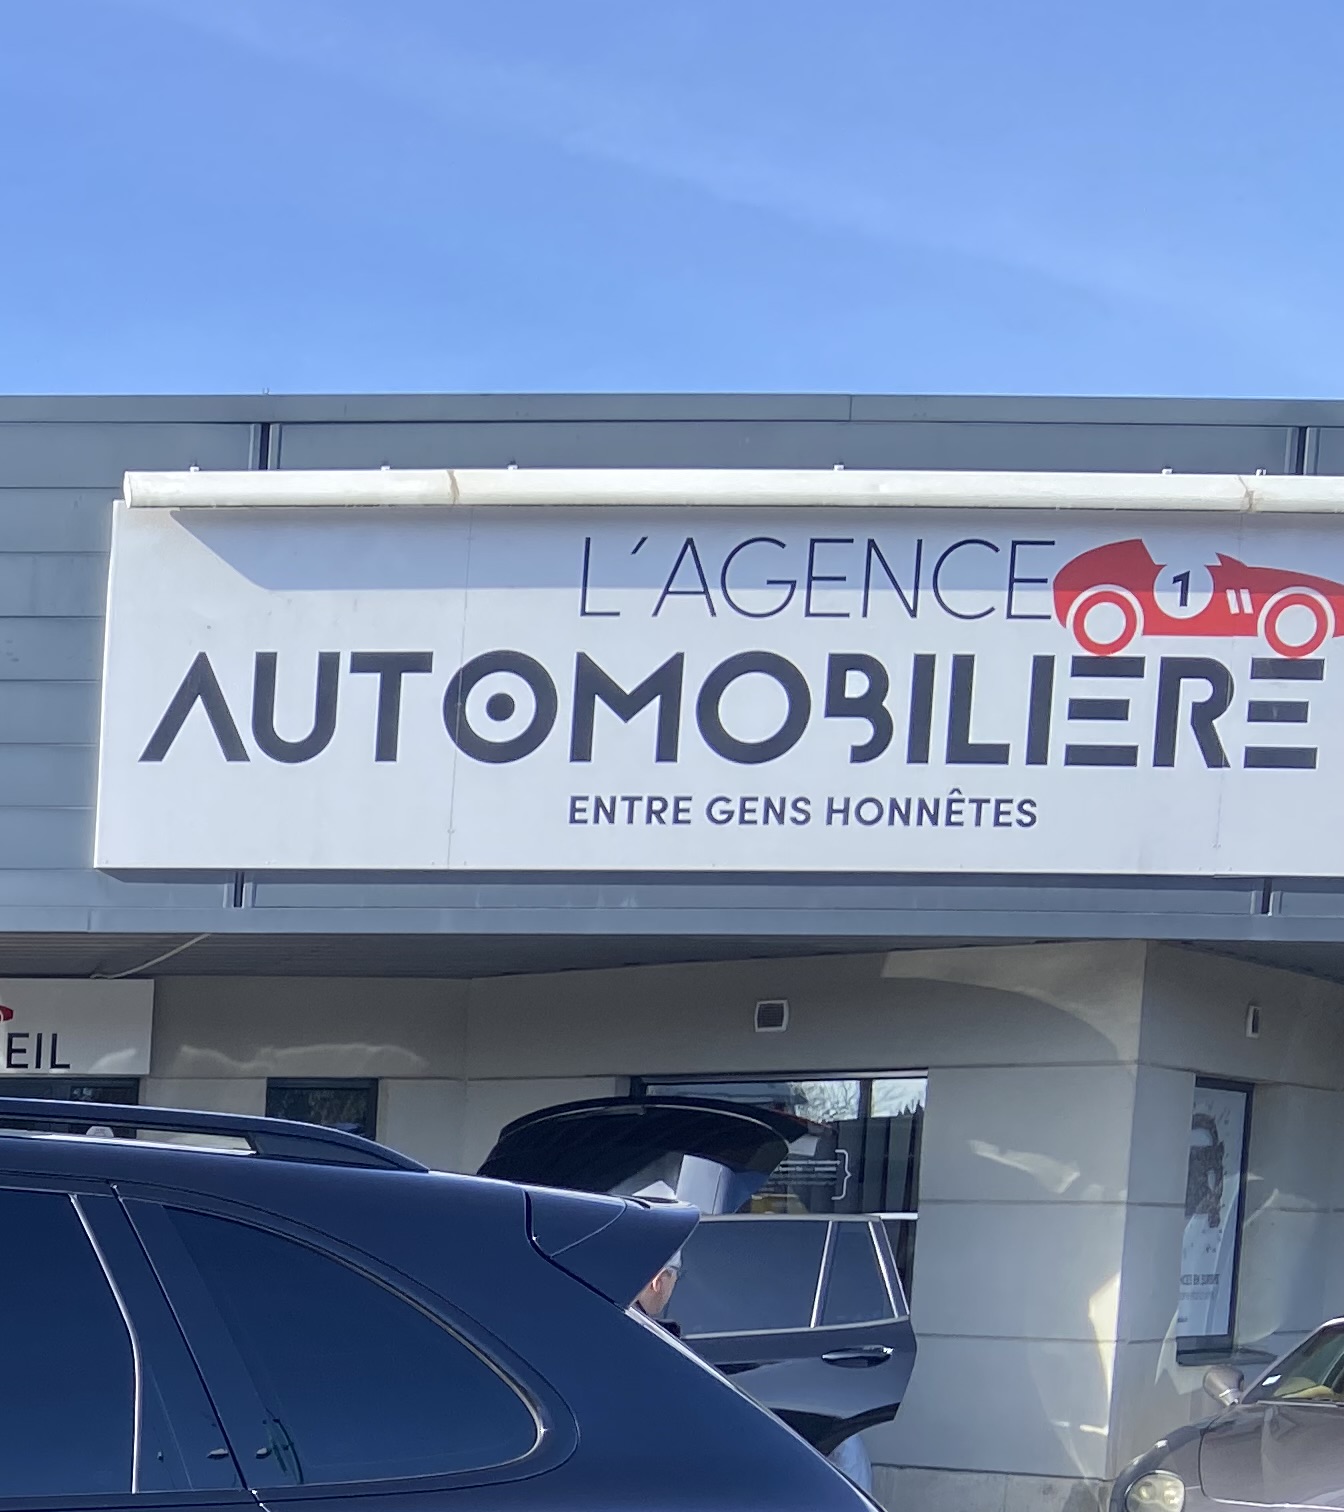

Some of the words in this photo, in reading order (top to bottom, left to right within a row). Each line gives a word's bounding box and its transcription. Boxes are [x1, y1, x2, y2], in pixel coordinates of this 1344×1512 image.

[1172, 570, 1192, 608] 1
[138, 649, 1326, 770] AUTOMOBILIERE
[569, 795, 693, 825] ENTRE
[705, 796, 812, 827] GENS
[826, 788, 1038, 829] HONNÊTES
